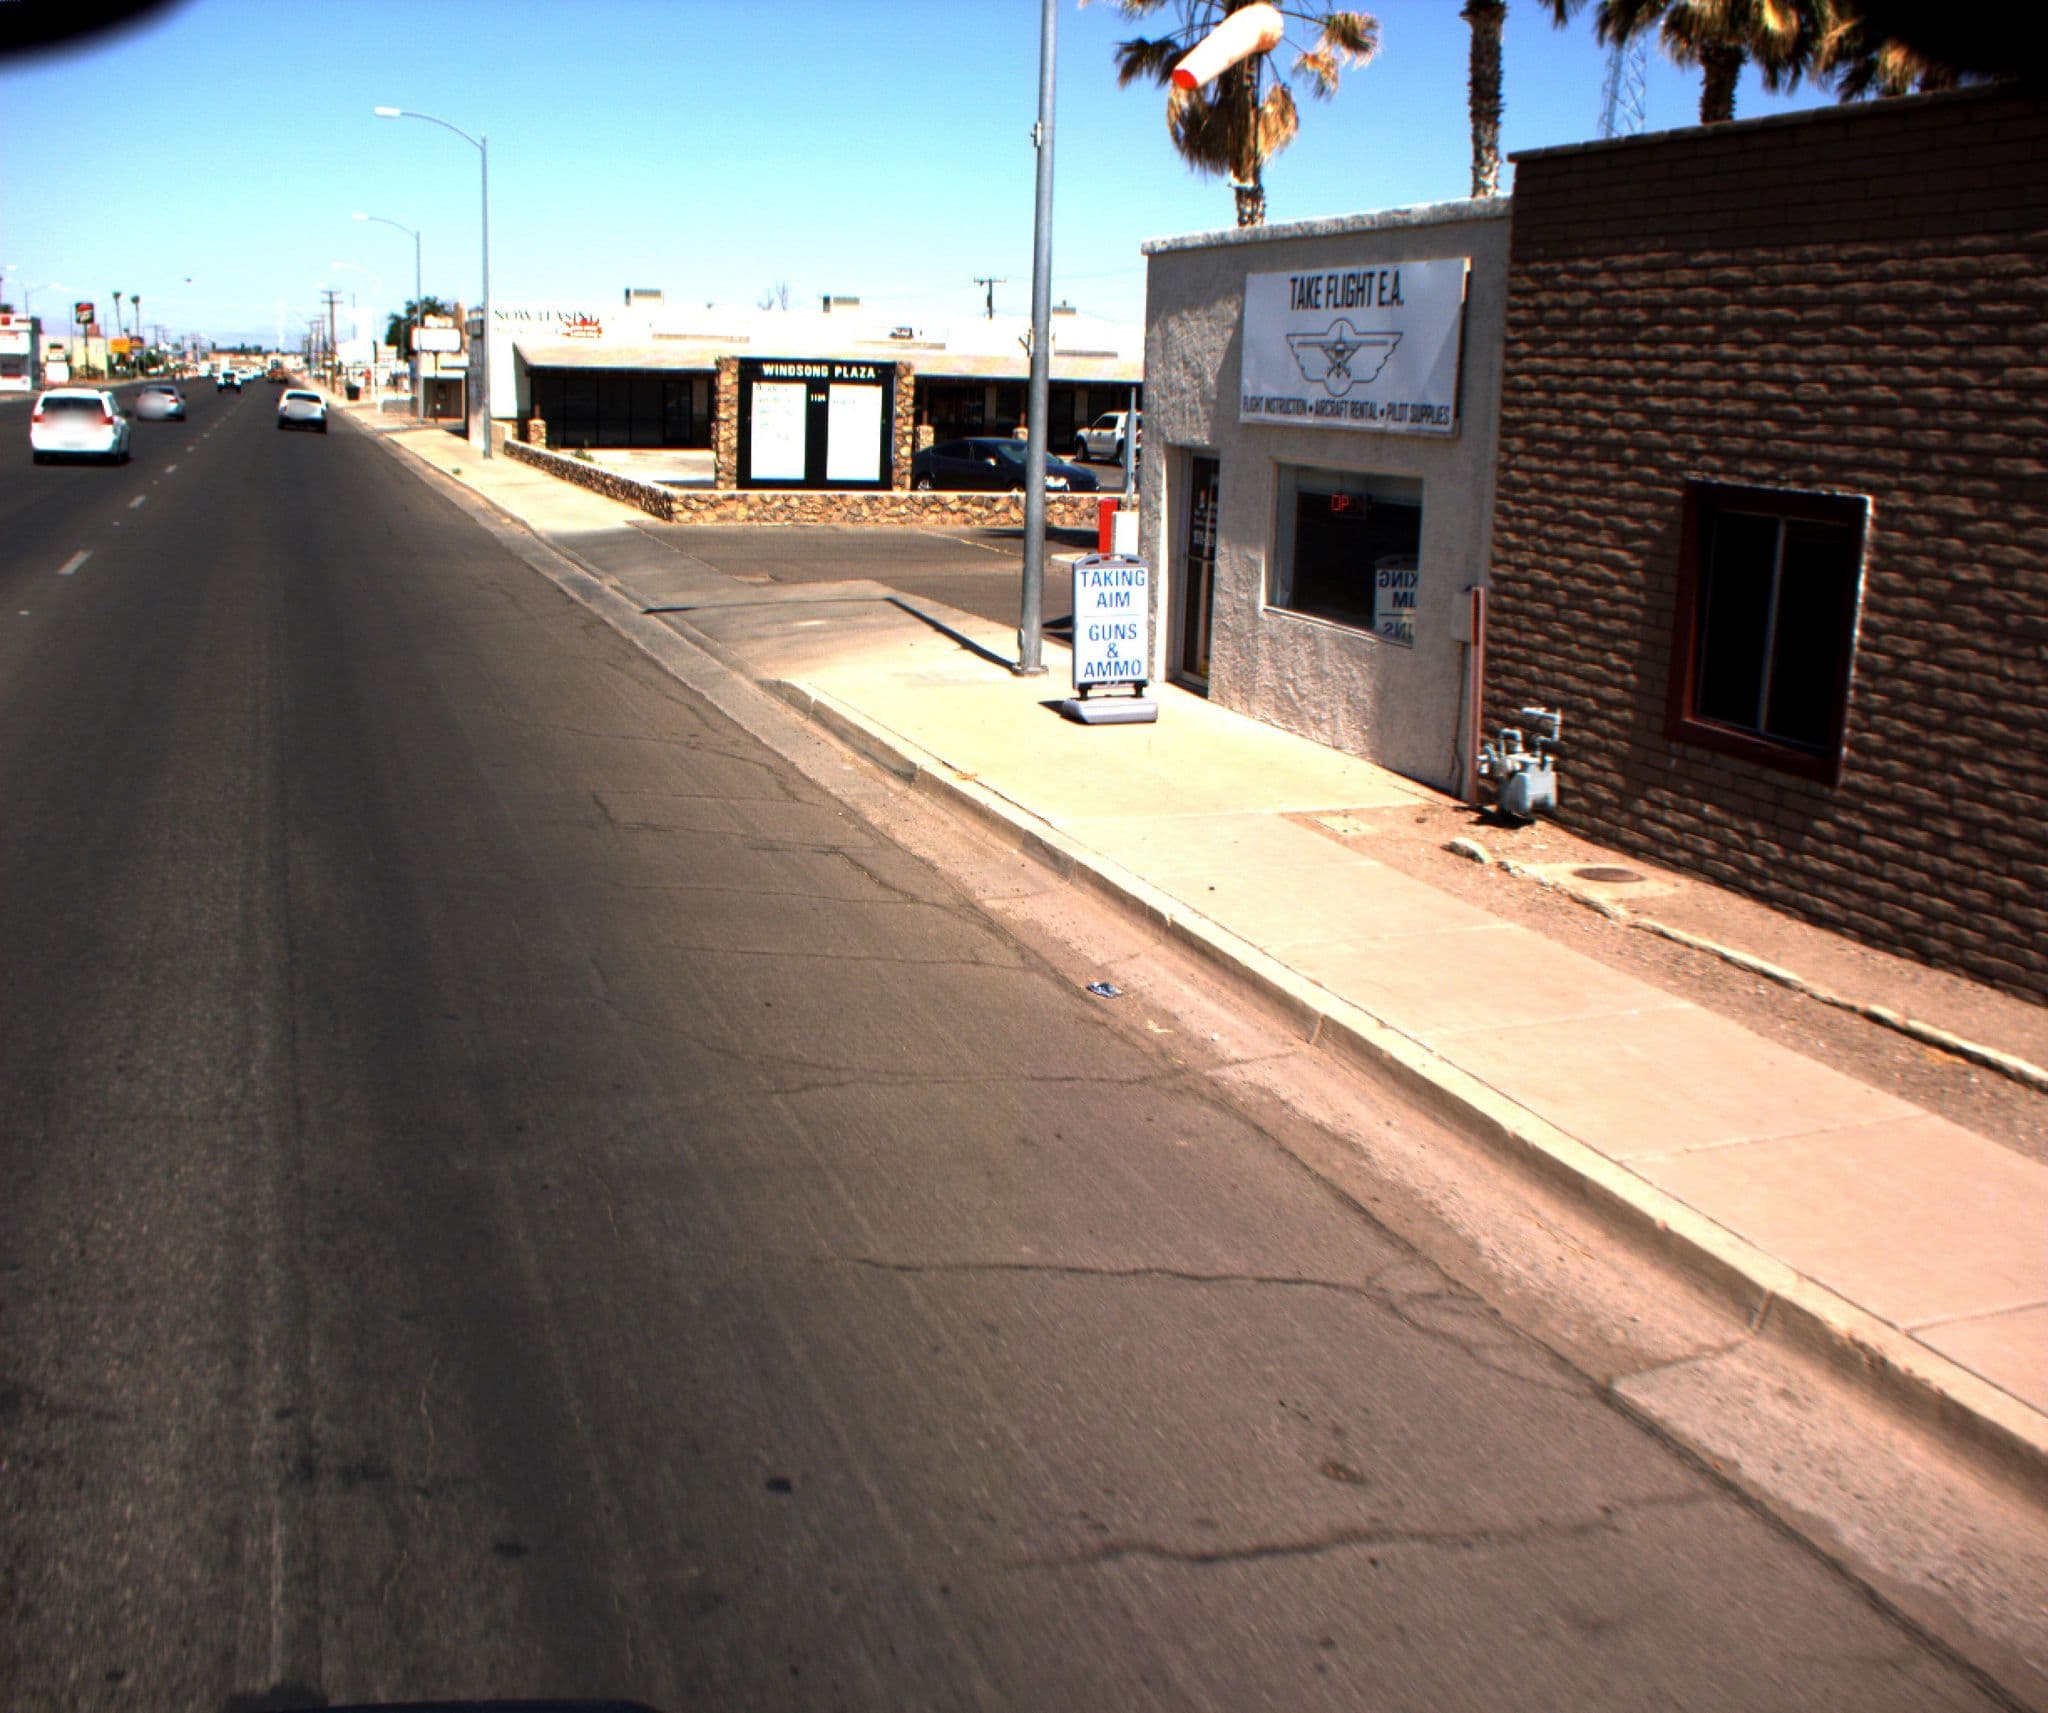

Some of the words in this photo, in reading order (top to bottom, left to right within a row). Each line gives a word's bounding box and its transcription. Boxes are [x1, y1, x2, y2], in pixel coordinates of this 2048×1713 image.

[1290, 276, 1321, 310] TAKE
[1326, 272, 1373, 309] FLIGHT
[762, 363, 829, 378] WINDSONG
[834, 365, 876, 379] PLAZA
[1313, 399, 1348, 419] AIRCRAFT
[1350, 401, 1377, 420] RENTAL
[1387, 402, 1408, 422] PILOT
[1410, 404, 1450, 425] SUPPLIES
[1080, 569, 1145, 588] TAKING
[1096, 591, 1130, 608] AIM
[1089, 623, 1137, 641] GUNS
[1107, 642, 1119, 659] &
[1084, 659, 1142, 678] AMMO
